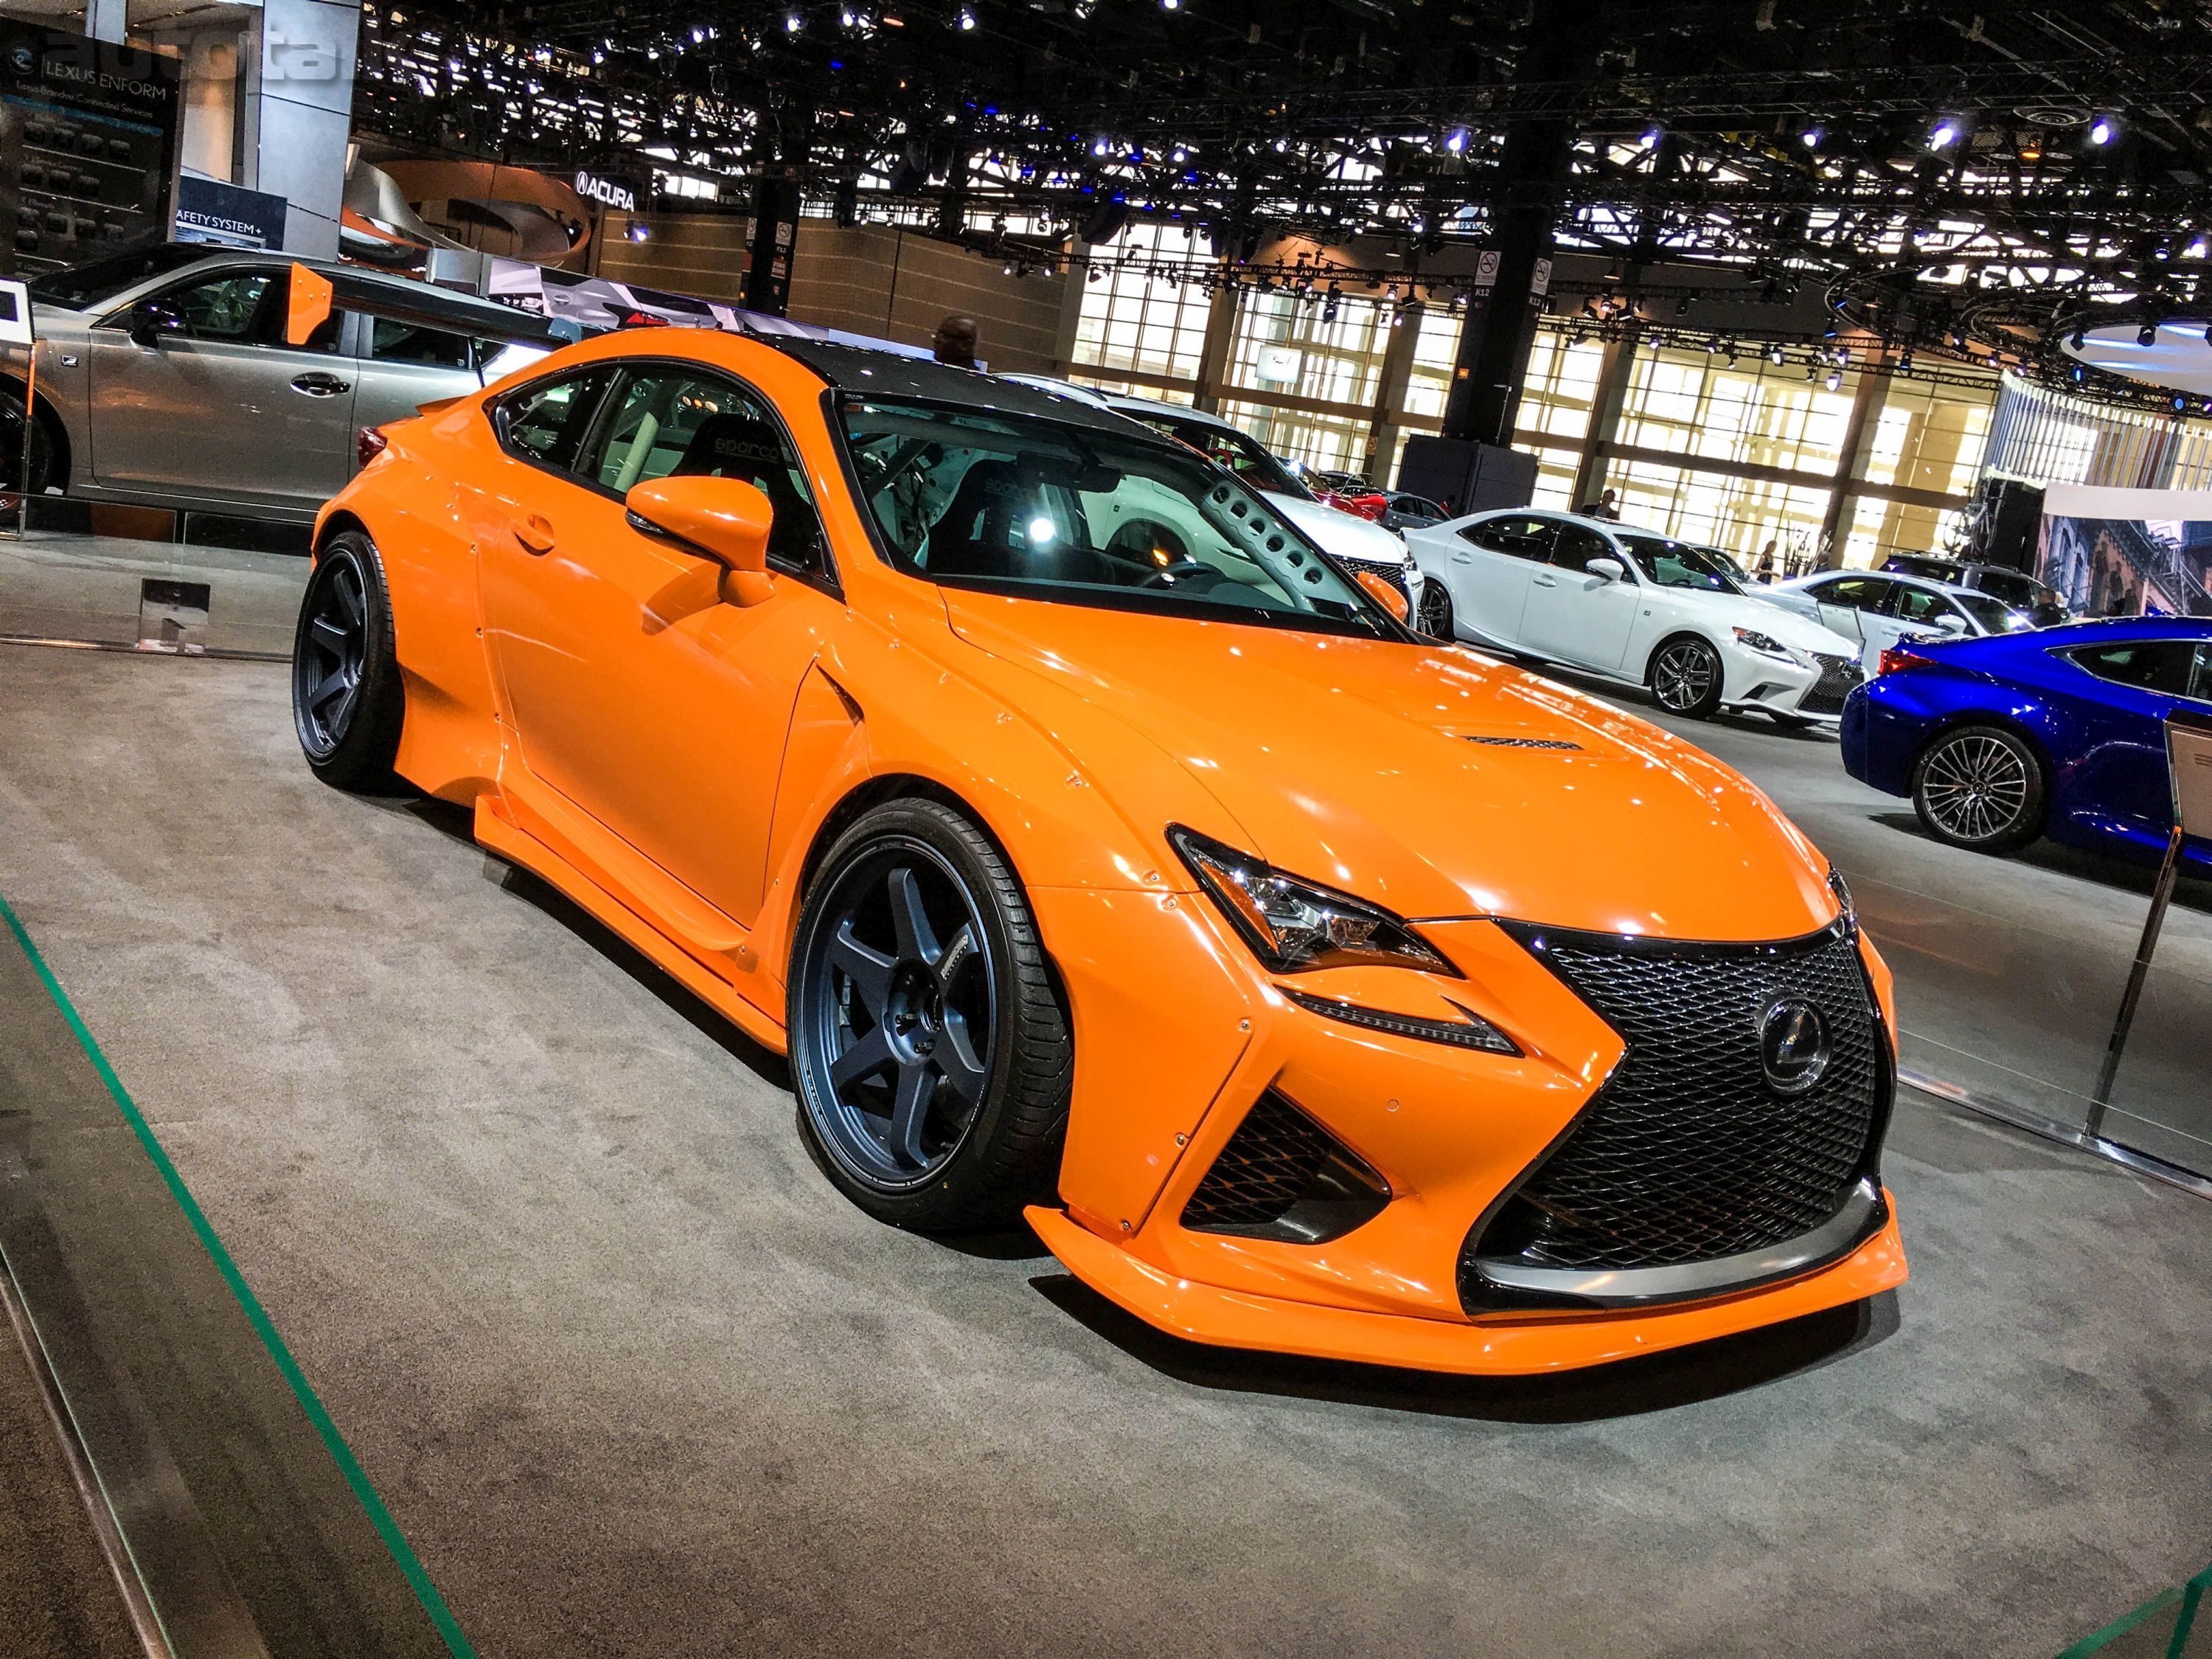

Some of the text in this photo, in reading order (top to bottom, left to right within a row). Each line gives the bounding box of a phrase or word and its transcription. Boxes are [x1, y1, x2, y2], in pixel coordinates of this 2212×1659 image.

[46, 60, 167, 101] LEXUS ENFORM
[586, 177, 634, 213] ACURA
[212, 217, 254, 234] SYSTEM
[1475, 288, 1490, 296] K12
[1528, 296, 1541, 307] K12
[714, 438, 779, 460] sparco
